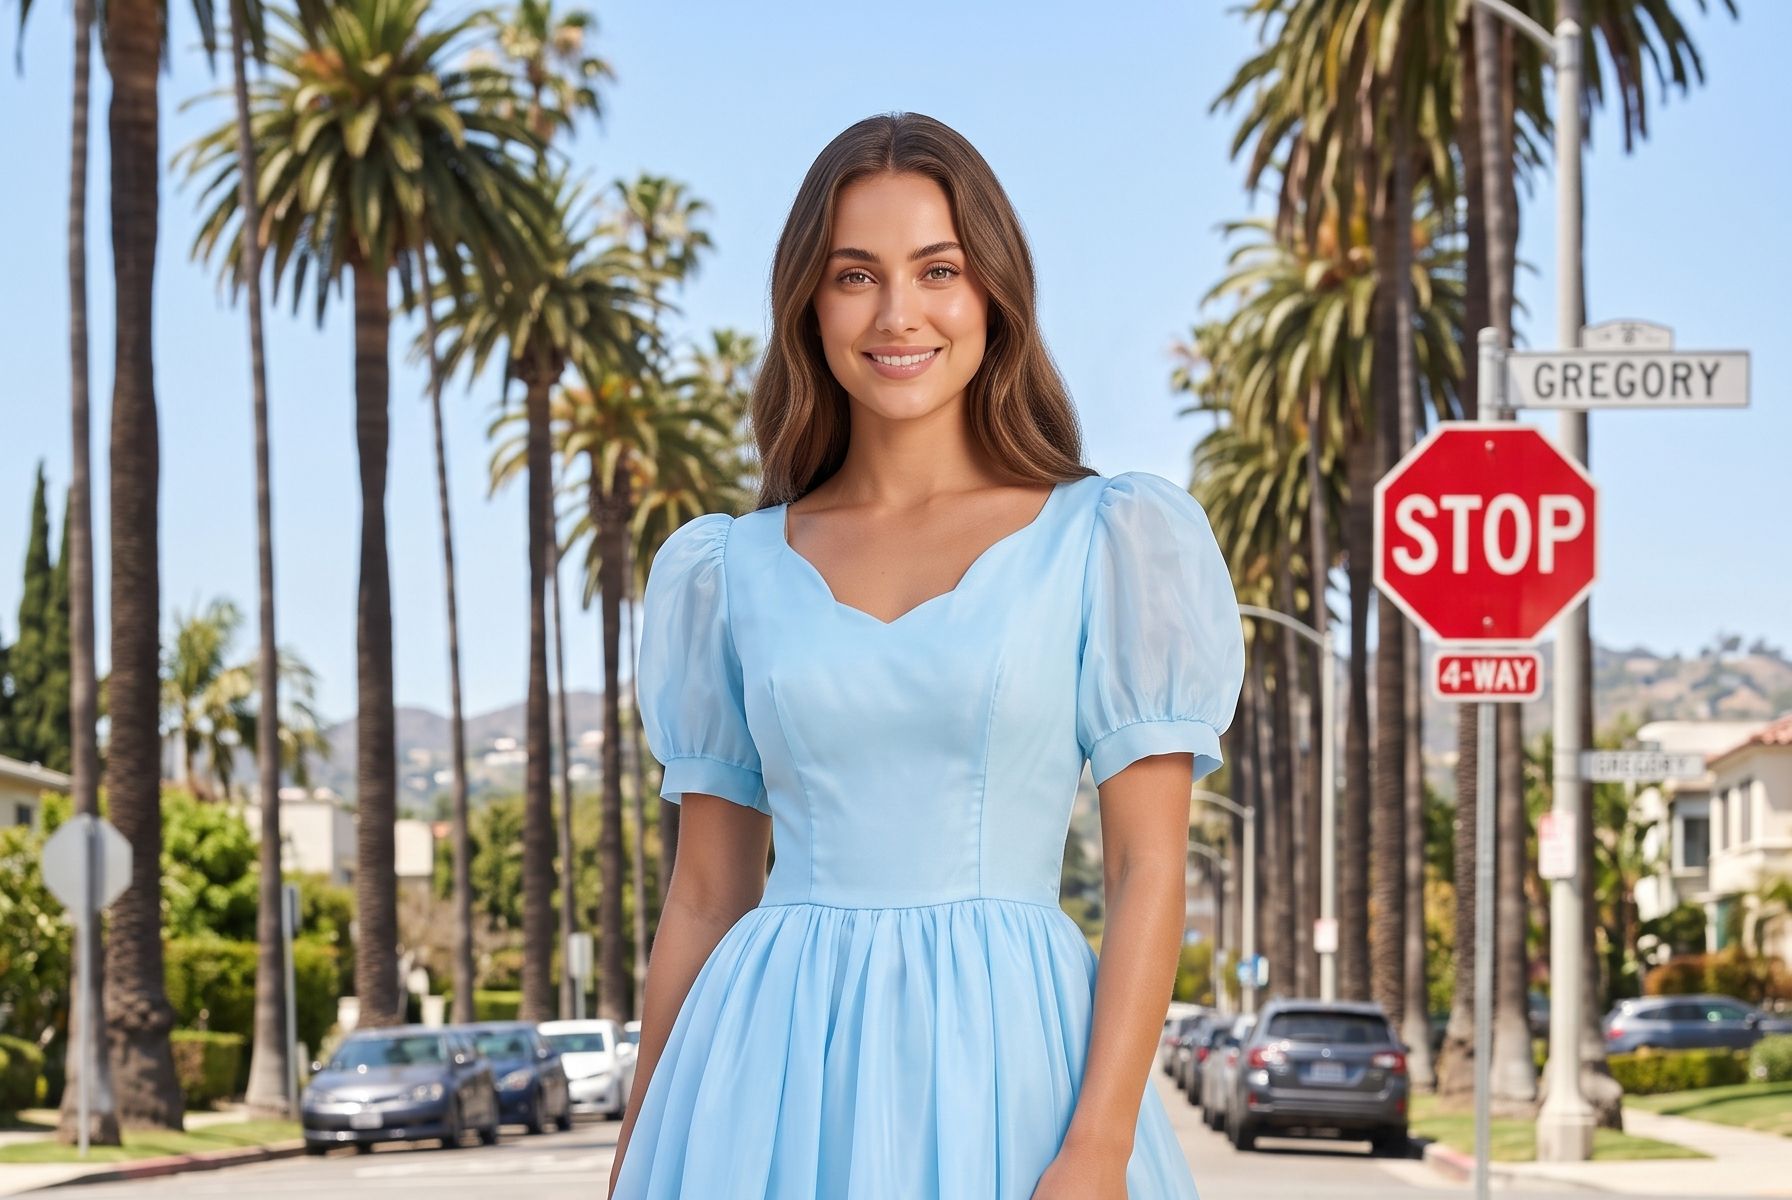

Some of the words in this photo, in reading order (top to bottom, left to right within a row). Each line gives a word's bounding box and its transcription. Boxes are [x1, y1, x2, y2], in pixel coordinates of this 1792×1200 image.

[1534, 361, 1721, 398] GREGORY
[1391, 493, 1586, 576] STOP
[1440, 658, 1533, 691] 4-WAY
